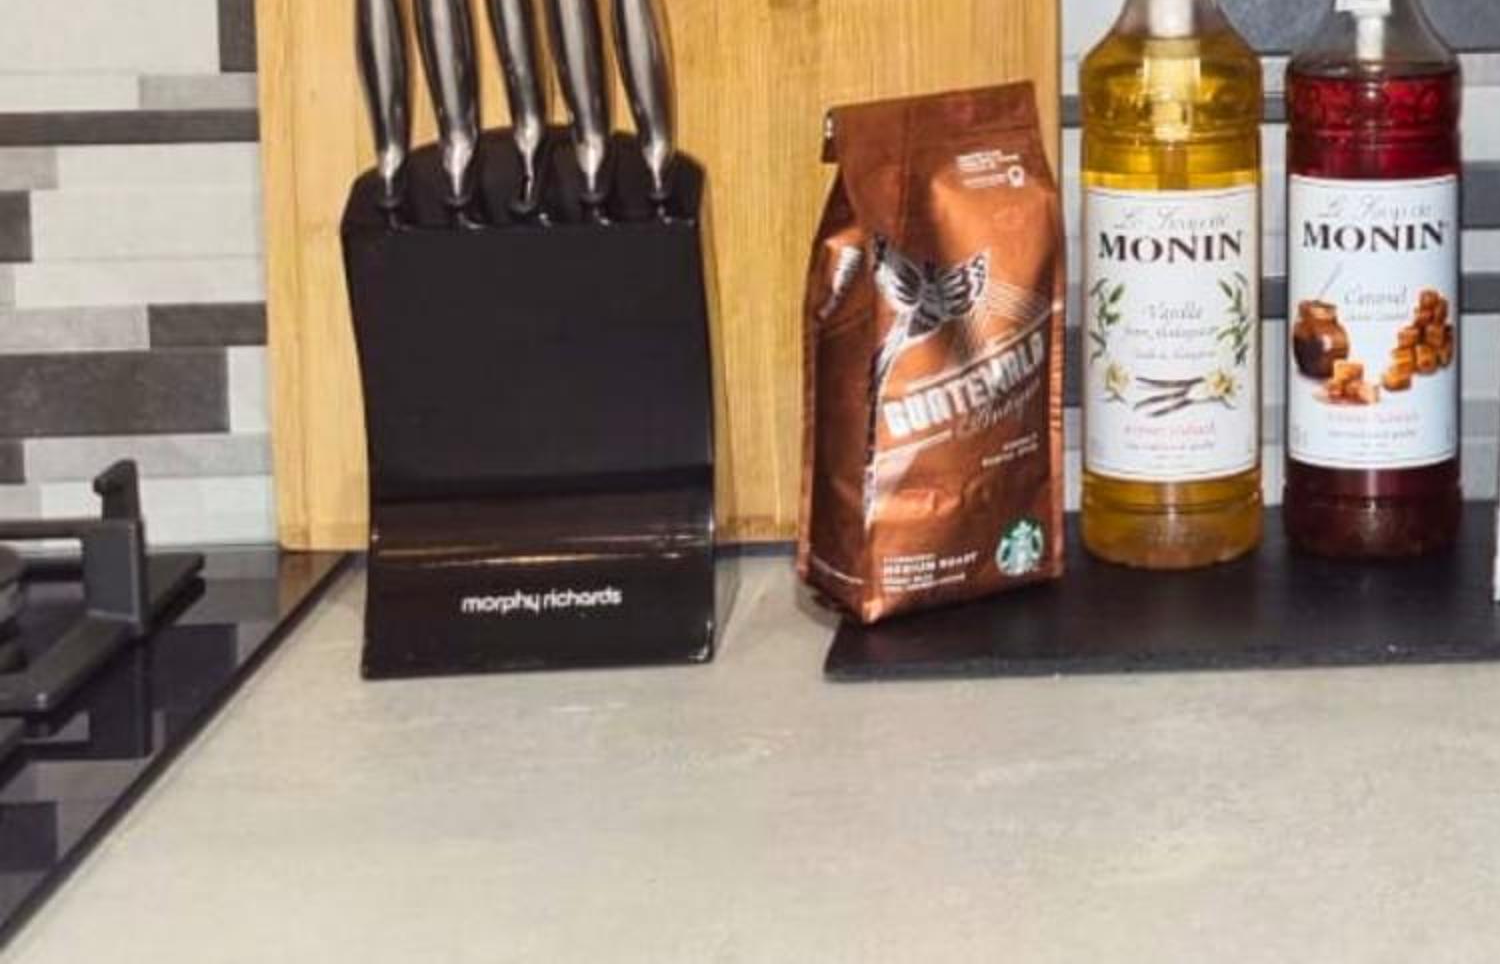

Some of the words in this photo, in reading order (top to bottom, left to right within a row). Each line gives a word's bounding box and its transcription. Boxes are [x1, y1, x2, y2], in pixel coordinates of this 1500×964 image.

[1098, 230, 1242, 264] MONIN
[1302, 219, 1444, 252] MONIN
[461, 588, 541, 616] morphy
[544, 585, 623, 611] richards
